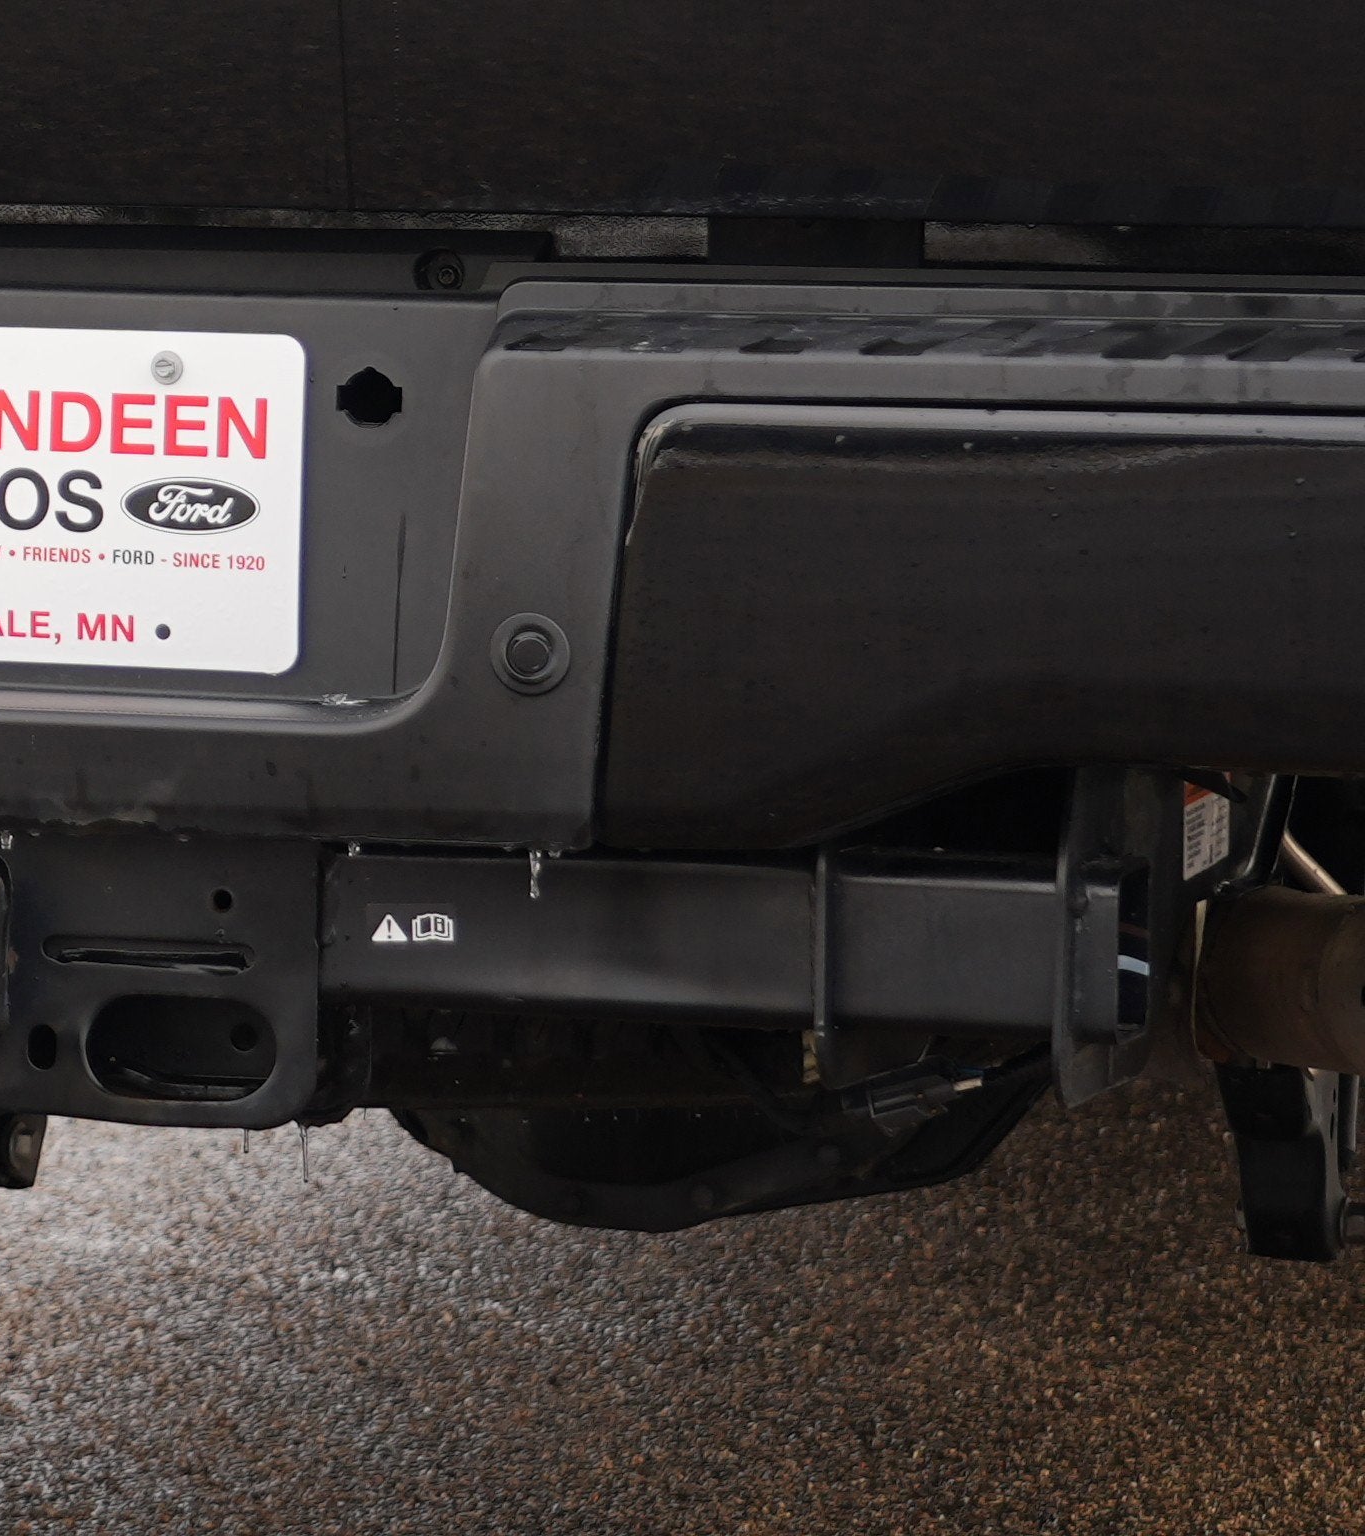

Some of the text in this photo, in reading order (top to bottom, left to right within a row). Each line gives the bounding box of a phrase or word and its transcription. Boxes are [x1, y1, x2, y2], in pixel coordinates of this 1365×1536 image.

[22, 546, 92, 564] FRIENDS
[112, 549, 155, 566] FORD
[172, 552, 221, 569] SINCE
[227, 554, 266, 571] 1920
[76, 611, 135, 643] MN
